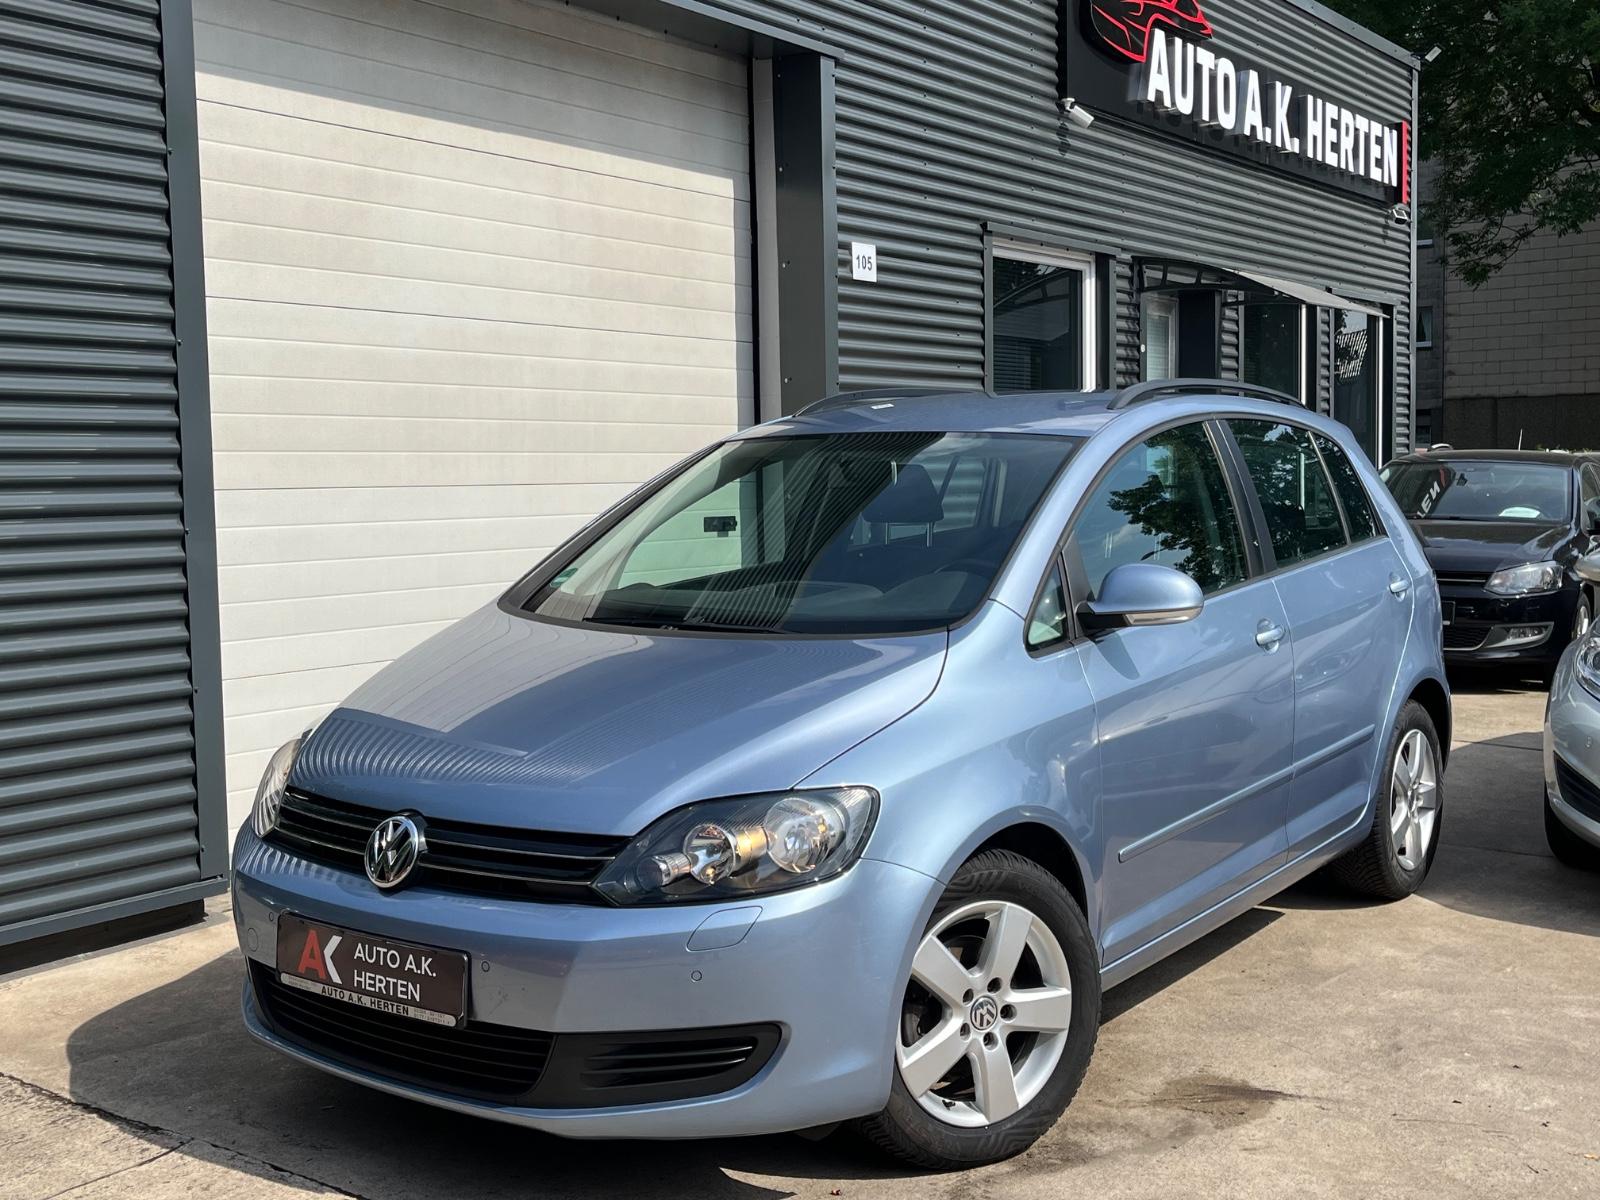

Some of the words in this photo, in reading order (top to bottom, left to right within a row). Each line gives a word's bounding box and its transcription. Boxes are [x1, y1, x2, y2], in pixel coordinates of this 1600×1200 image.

[1147, 28, 1237, 130] AUTO
[1243, 69, 1300, 154] A.K.
[1306, 94, 1398, 187] HERTEN
[856, 254, 873, 271] 105
[297, 929, 343, 984] AK
[353, 942, 401, 969] AUTO
[404, 956, 437, 978] A.K.
[321, 985, 345, 1000] AUTO
[369, 998, 409, 1016] HERTEN
[353, 969, 420, 1002] HERTEN
